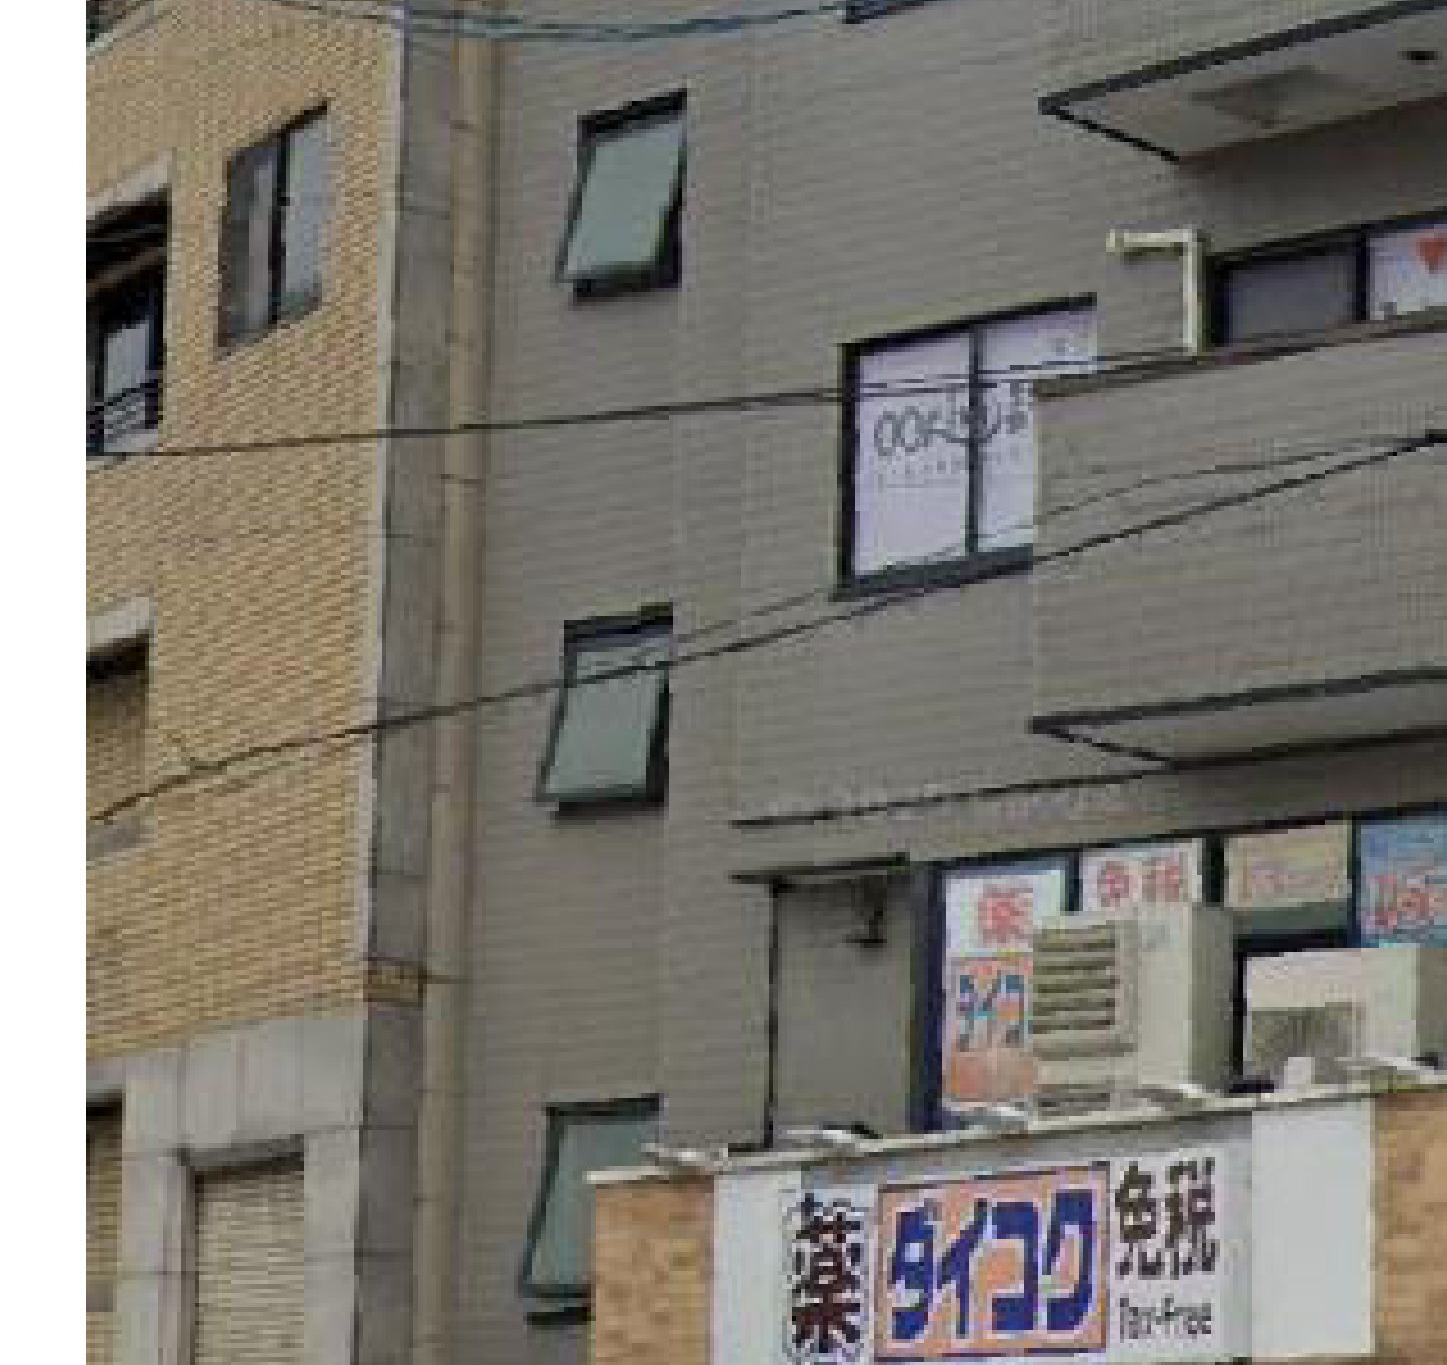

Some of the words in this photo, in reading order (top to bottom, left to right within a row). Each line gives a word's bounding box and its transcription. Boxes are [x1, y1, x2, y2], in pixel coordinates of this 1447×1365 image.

[790, 1193, 864, 1362] 薬
[889, 1188, 1096, 1343] ダイコク
[1115, 1157, 1218, 1278] 免税
